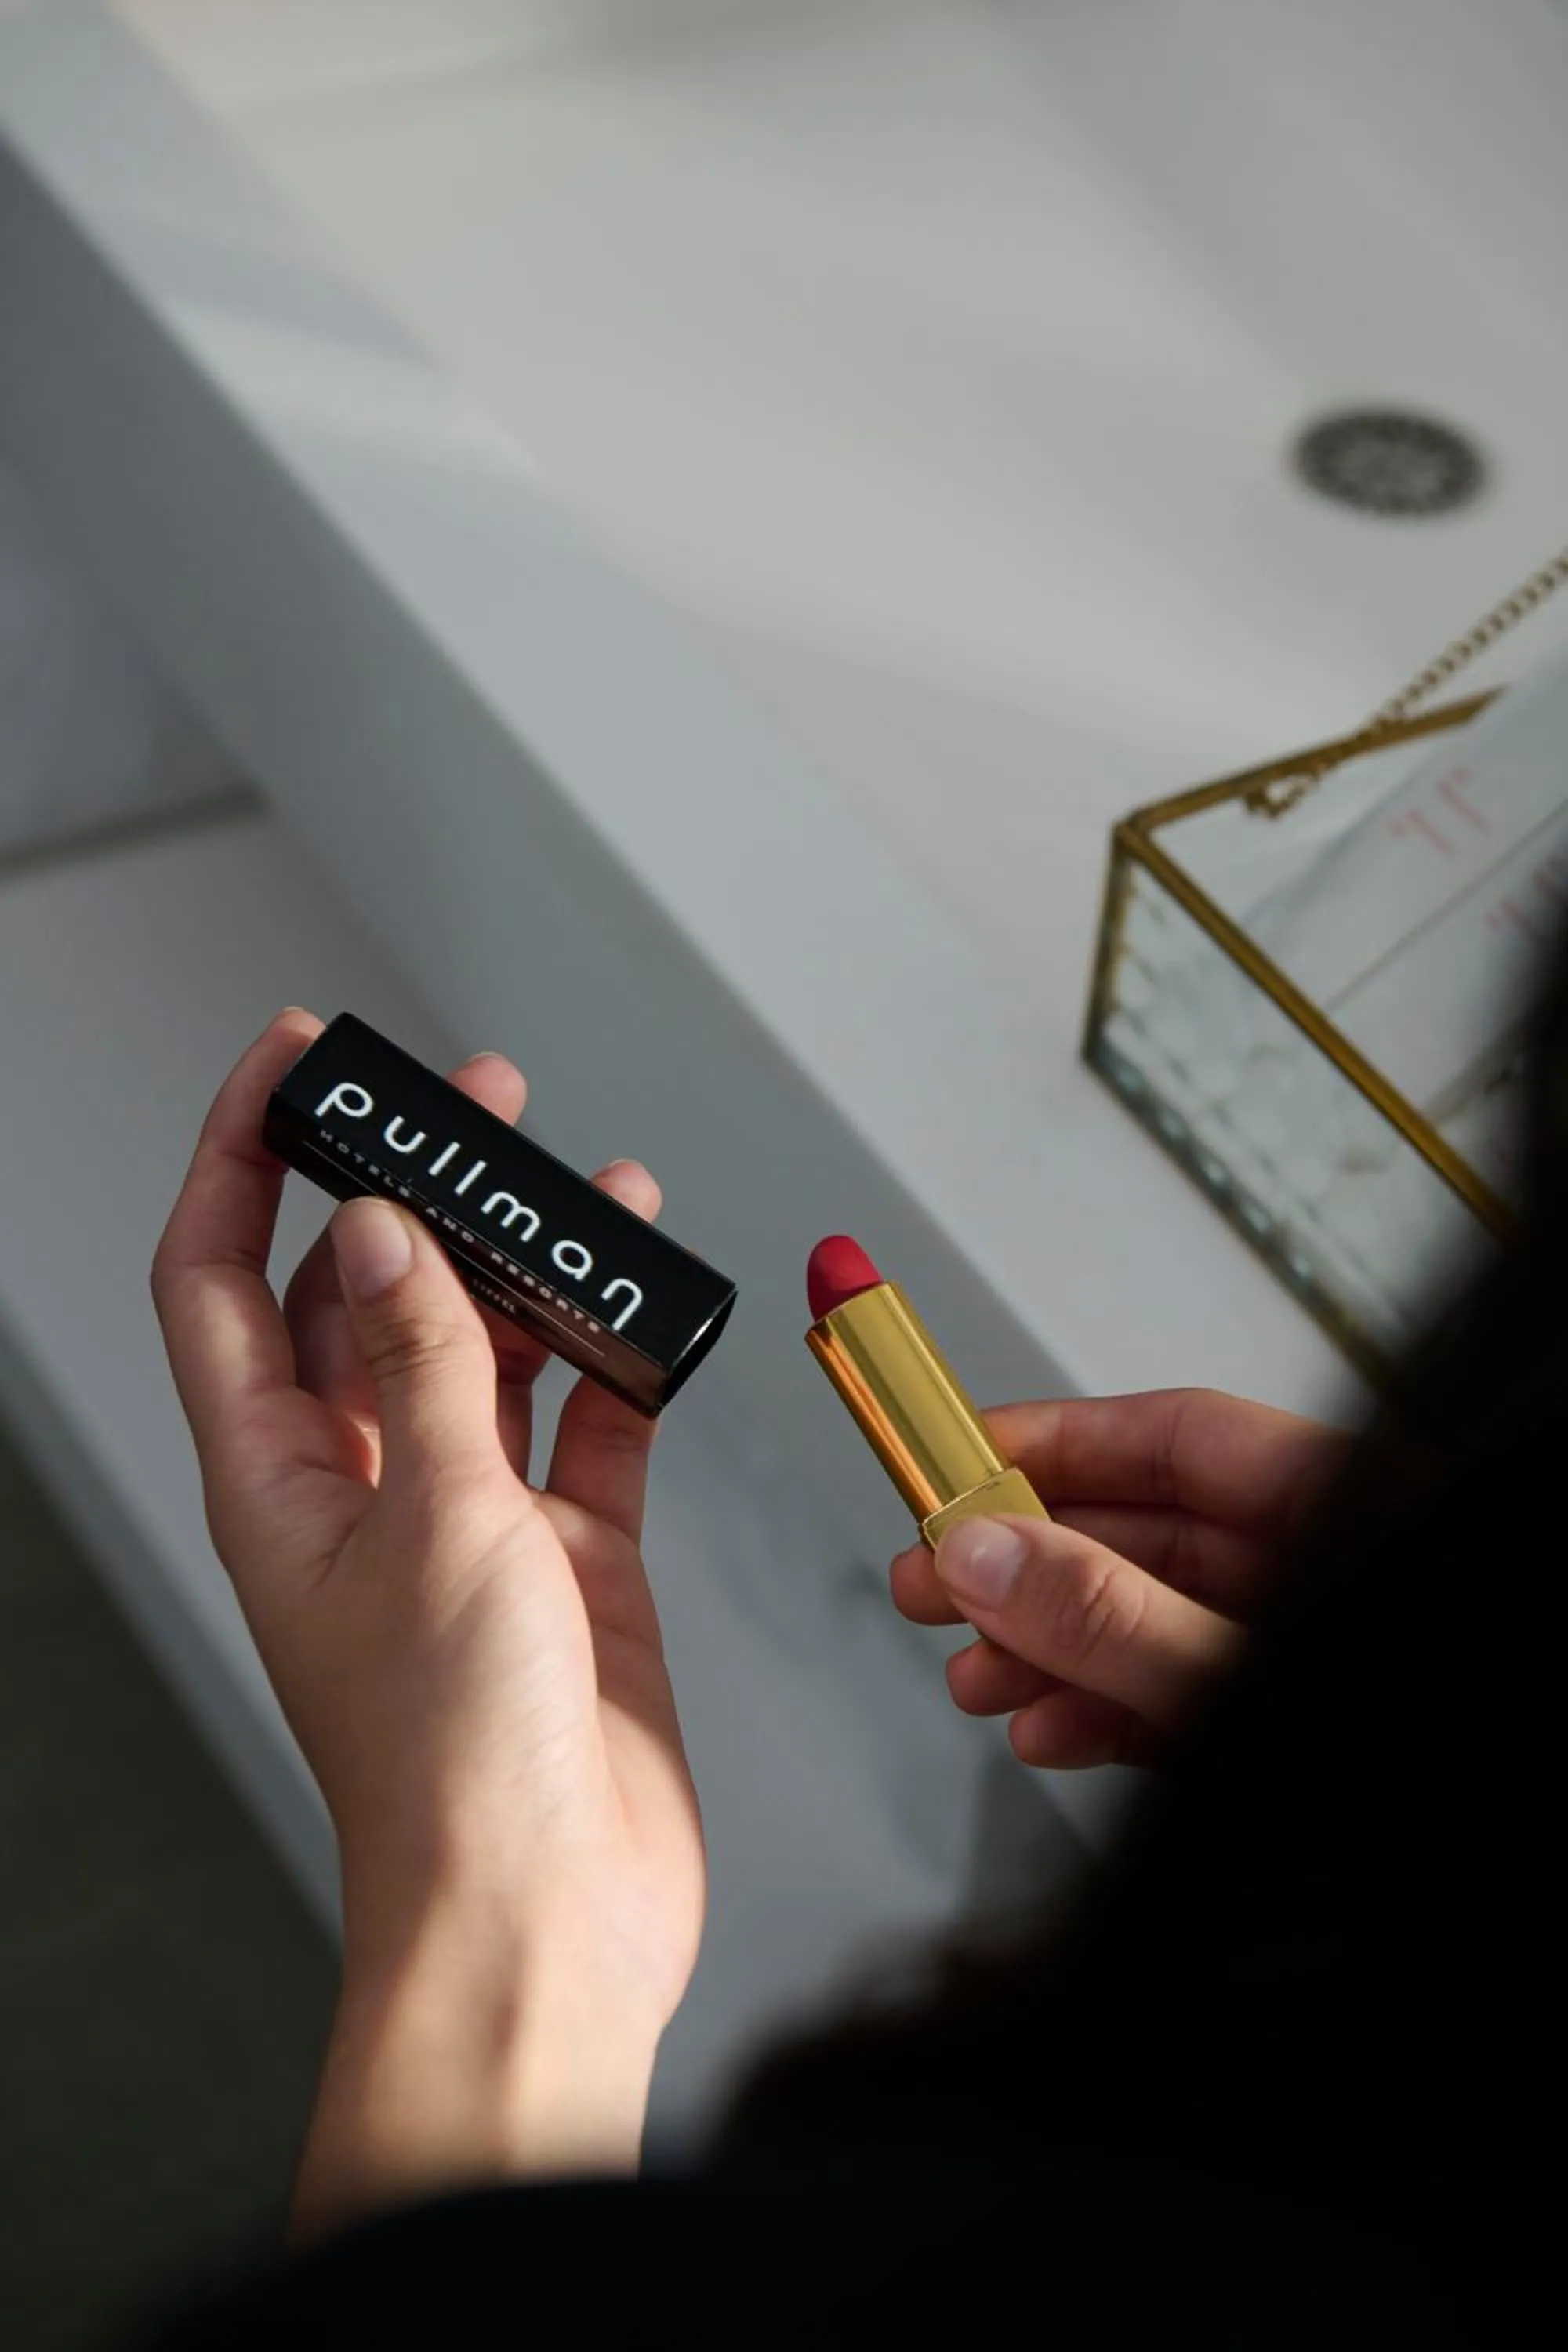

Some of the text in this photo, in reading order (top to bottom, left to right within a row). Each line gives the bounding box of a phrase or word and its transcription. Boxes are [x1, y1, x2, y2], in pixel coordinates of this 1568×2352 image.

[315, 1082, 643, 1331] pullman
[320, 1130, 410, 1198] HOTELS
[426, 1207, 474, 1243] AND
[490, 1251, 601, 1333] RESORTS
